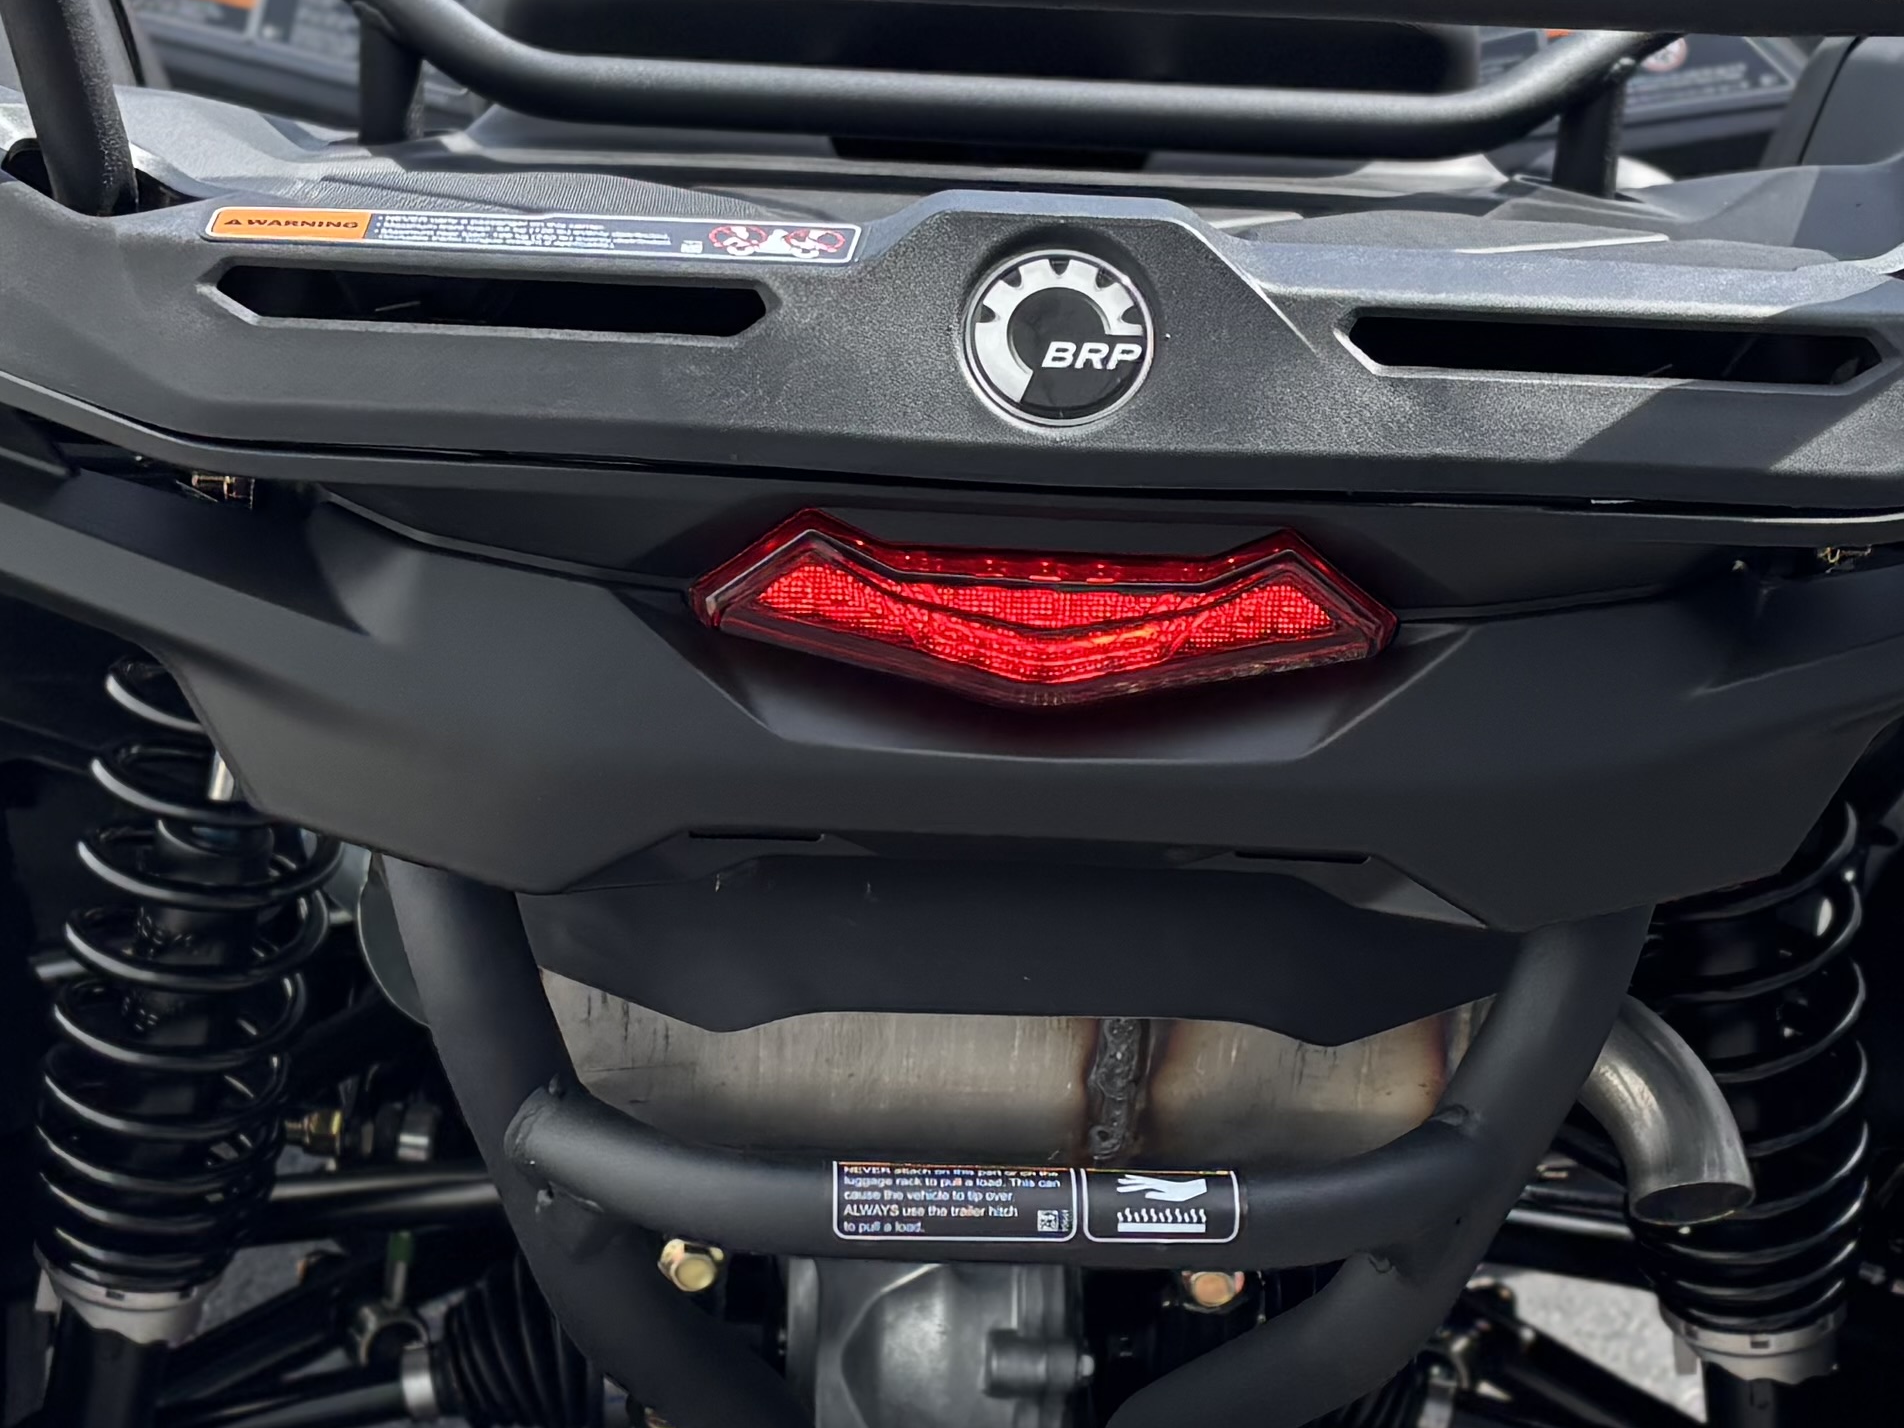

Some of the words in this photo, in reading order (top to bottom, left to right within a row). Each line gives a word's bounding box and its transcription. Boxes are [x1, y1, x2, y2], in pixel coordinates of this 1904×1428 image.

[247, 219, 359, 229] WARNING
[1041, 340, 1143, 370] BRP
[843, 1176, 893, 1188] luggage
[896, 1177, 922, 1186] rack
[925, 1177, 938, 1187] to
[940, 1177, 963, 1188] pull
[964, 1179, 974, 1187] a
[1008, 1177, 1036, 1188] This
[1038, 1179, 1061, 1188] can
[843, 1191, 882, 1201] cause
[883, 1190, 904, 1201] the
[906, 1190, 950, 1201] vehicle
[952, 1190, 965, 1202] to
[967, 1191, 984, 1203] tip
[843, 1204, 900, 1217] ALWAYS
[902, 1206, 926, 1217] use
[928, 1205, 948, 1217] the
[950, 1205, 986, 1218] trailer
[988, 1205, 1019, 1218] hitch
[843, 1220, 856, 1232] to
[858, 1220, 882, 1234] pull
[883, 1222, 893, 1233] a
